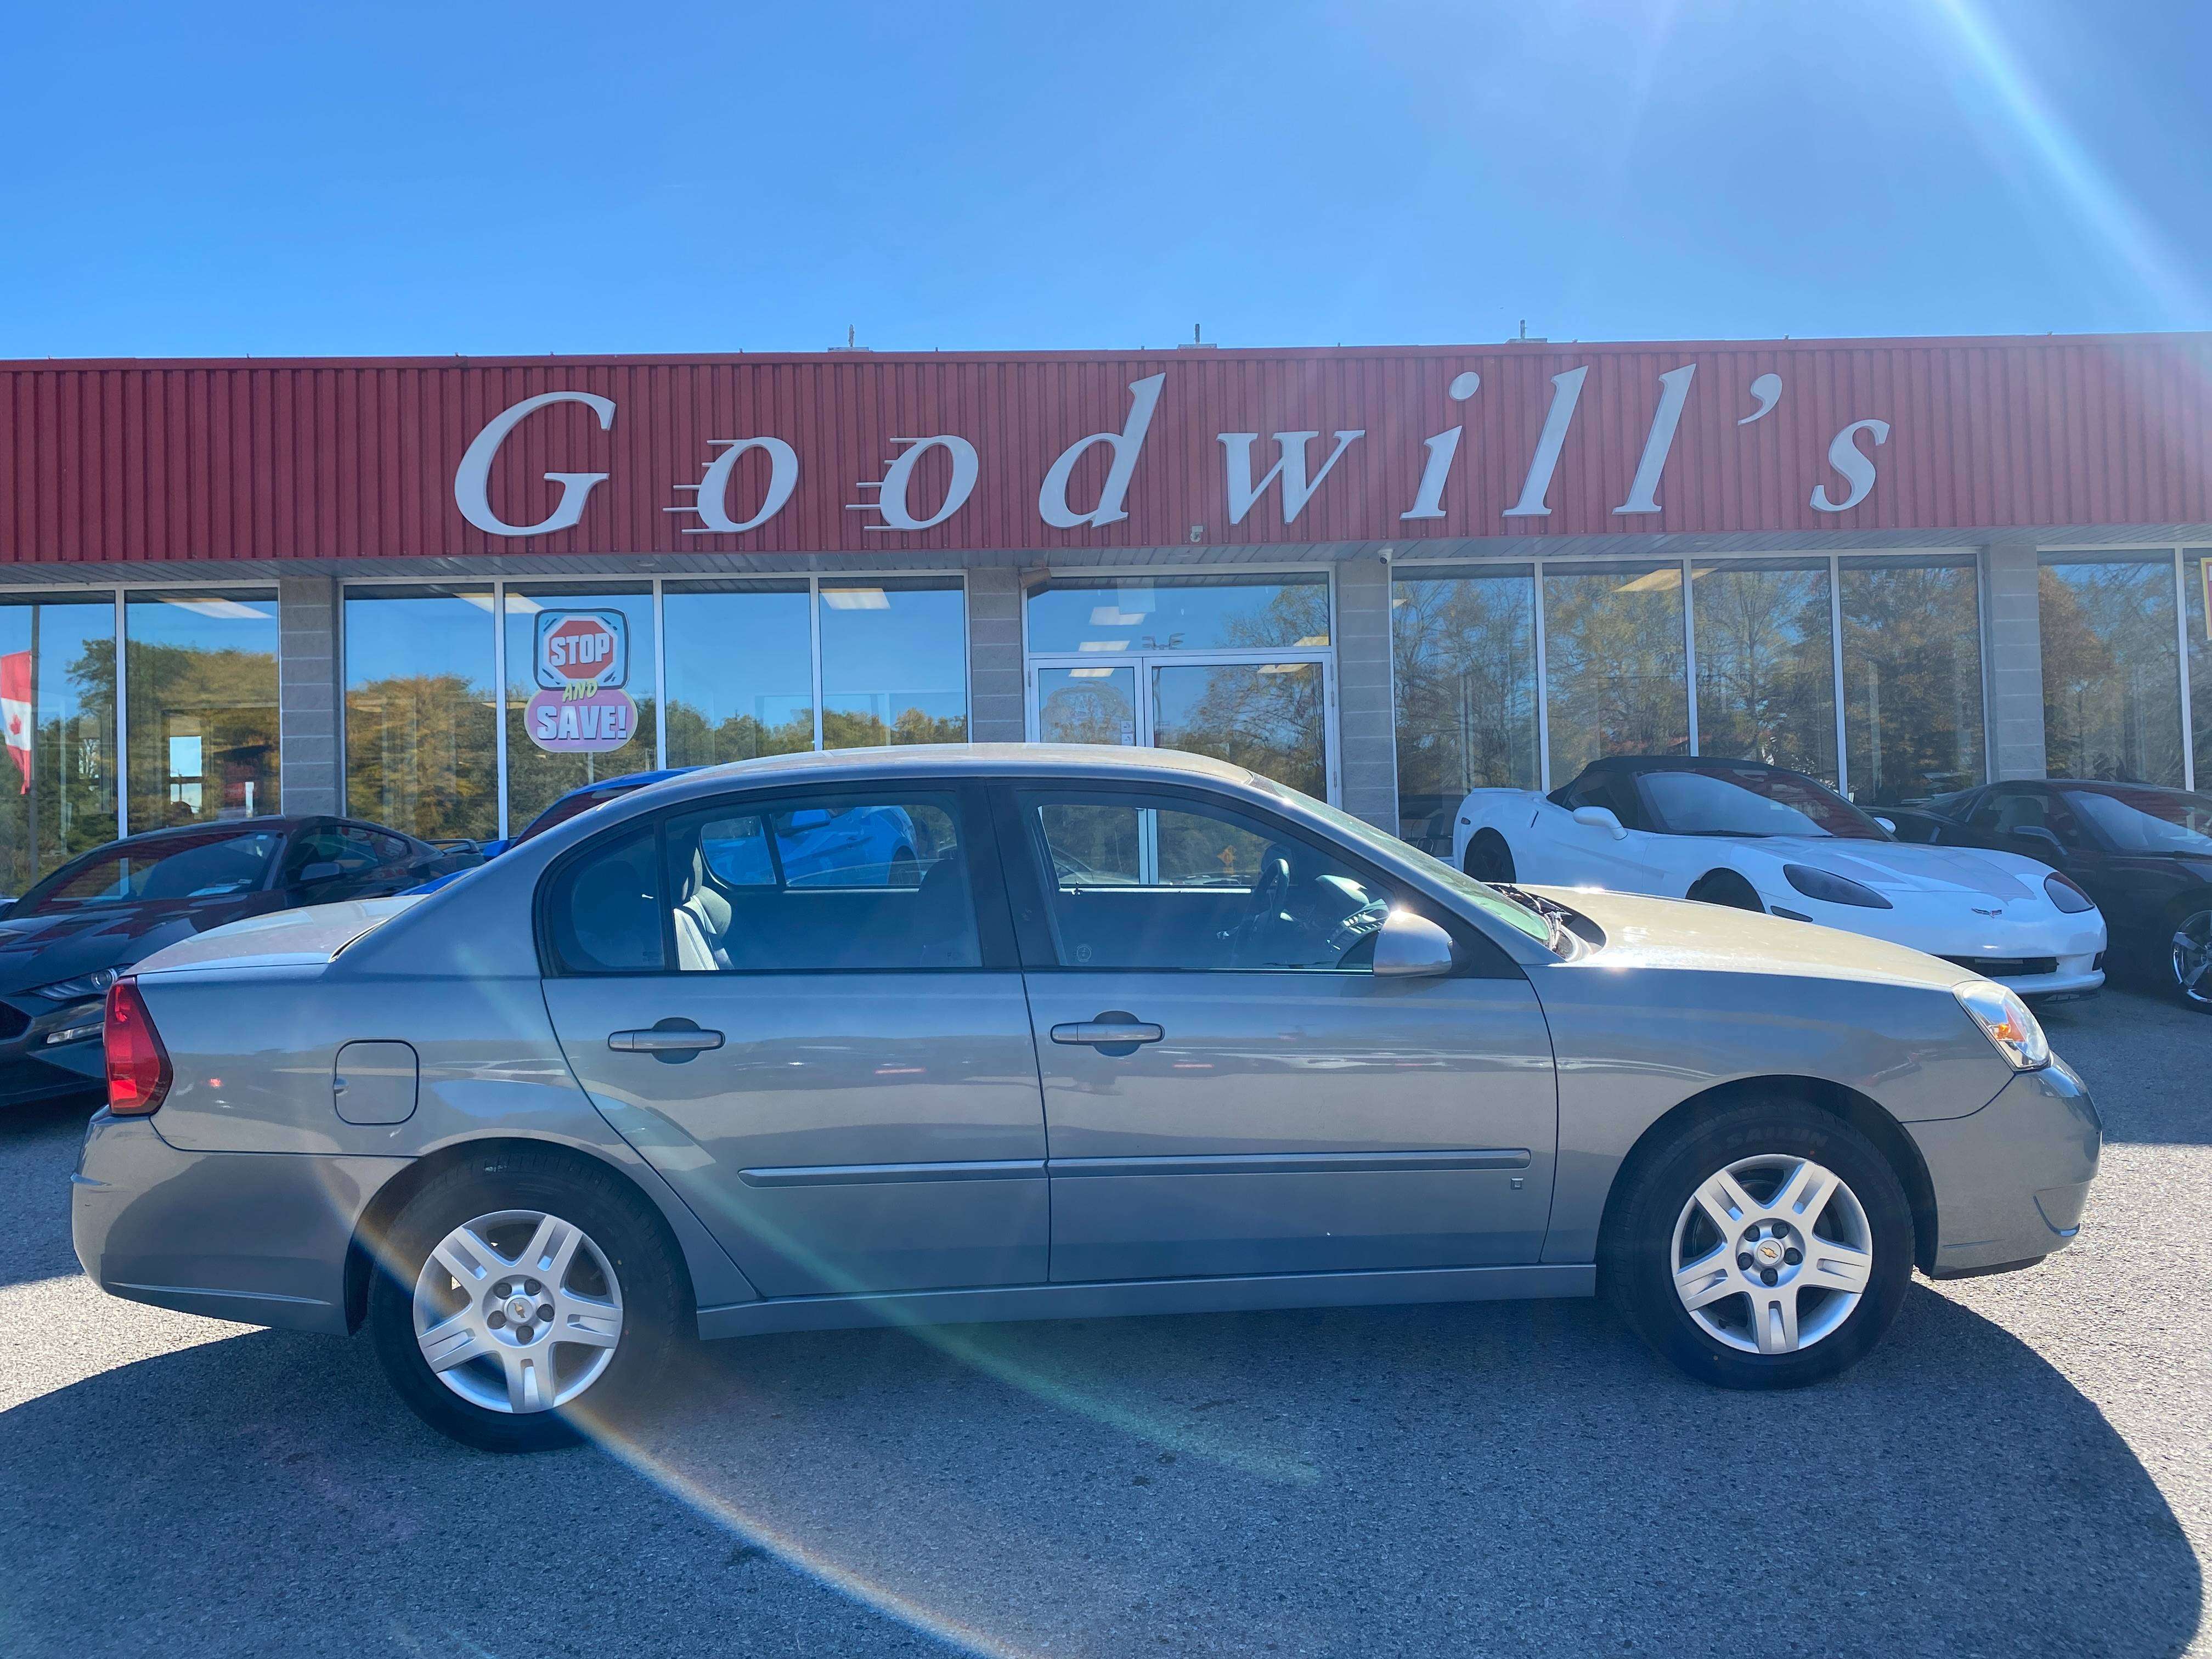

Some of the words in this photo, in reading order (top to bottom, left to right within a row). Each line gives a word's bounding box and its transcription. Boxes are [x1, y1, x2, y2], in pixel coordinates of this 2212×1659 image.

[454, 363, 1891, 537] Goodwill's
[550, 633, 610, 667] STOP
[562, 680, 598, 703] AND
[536, 705, 628, 740] SAVE!
